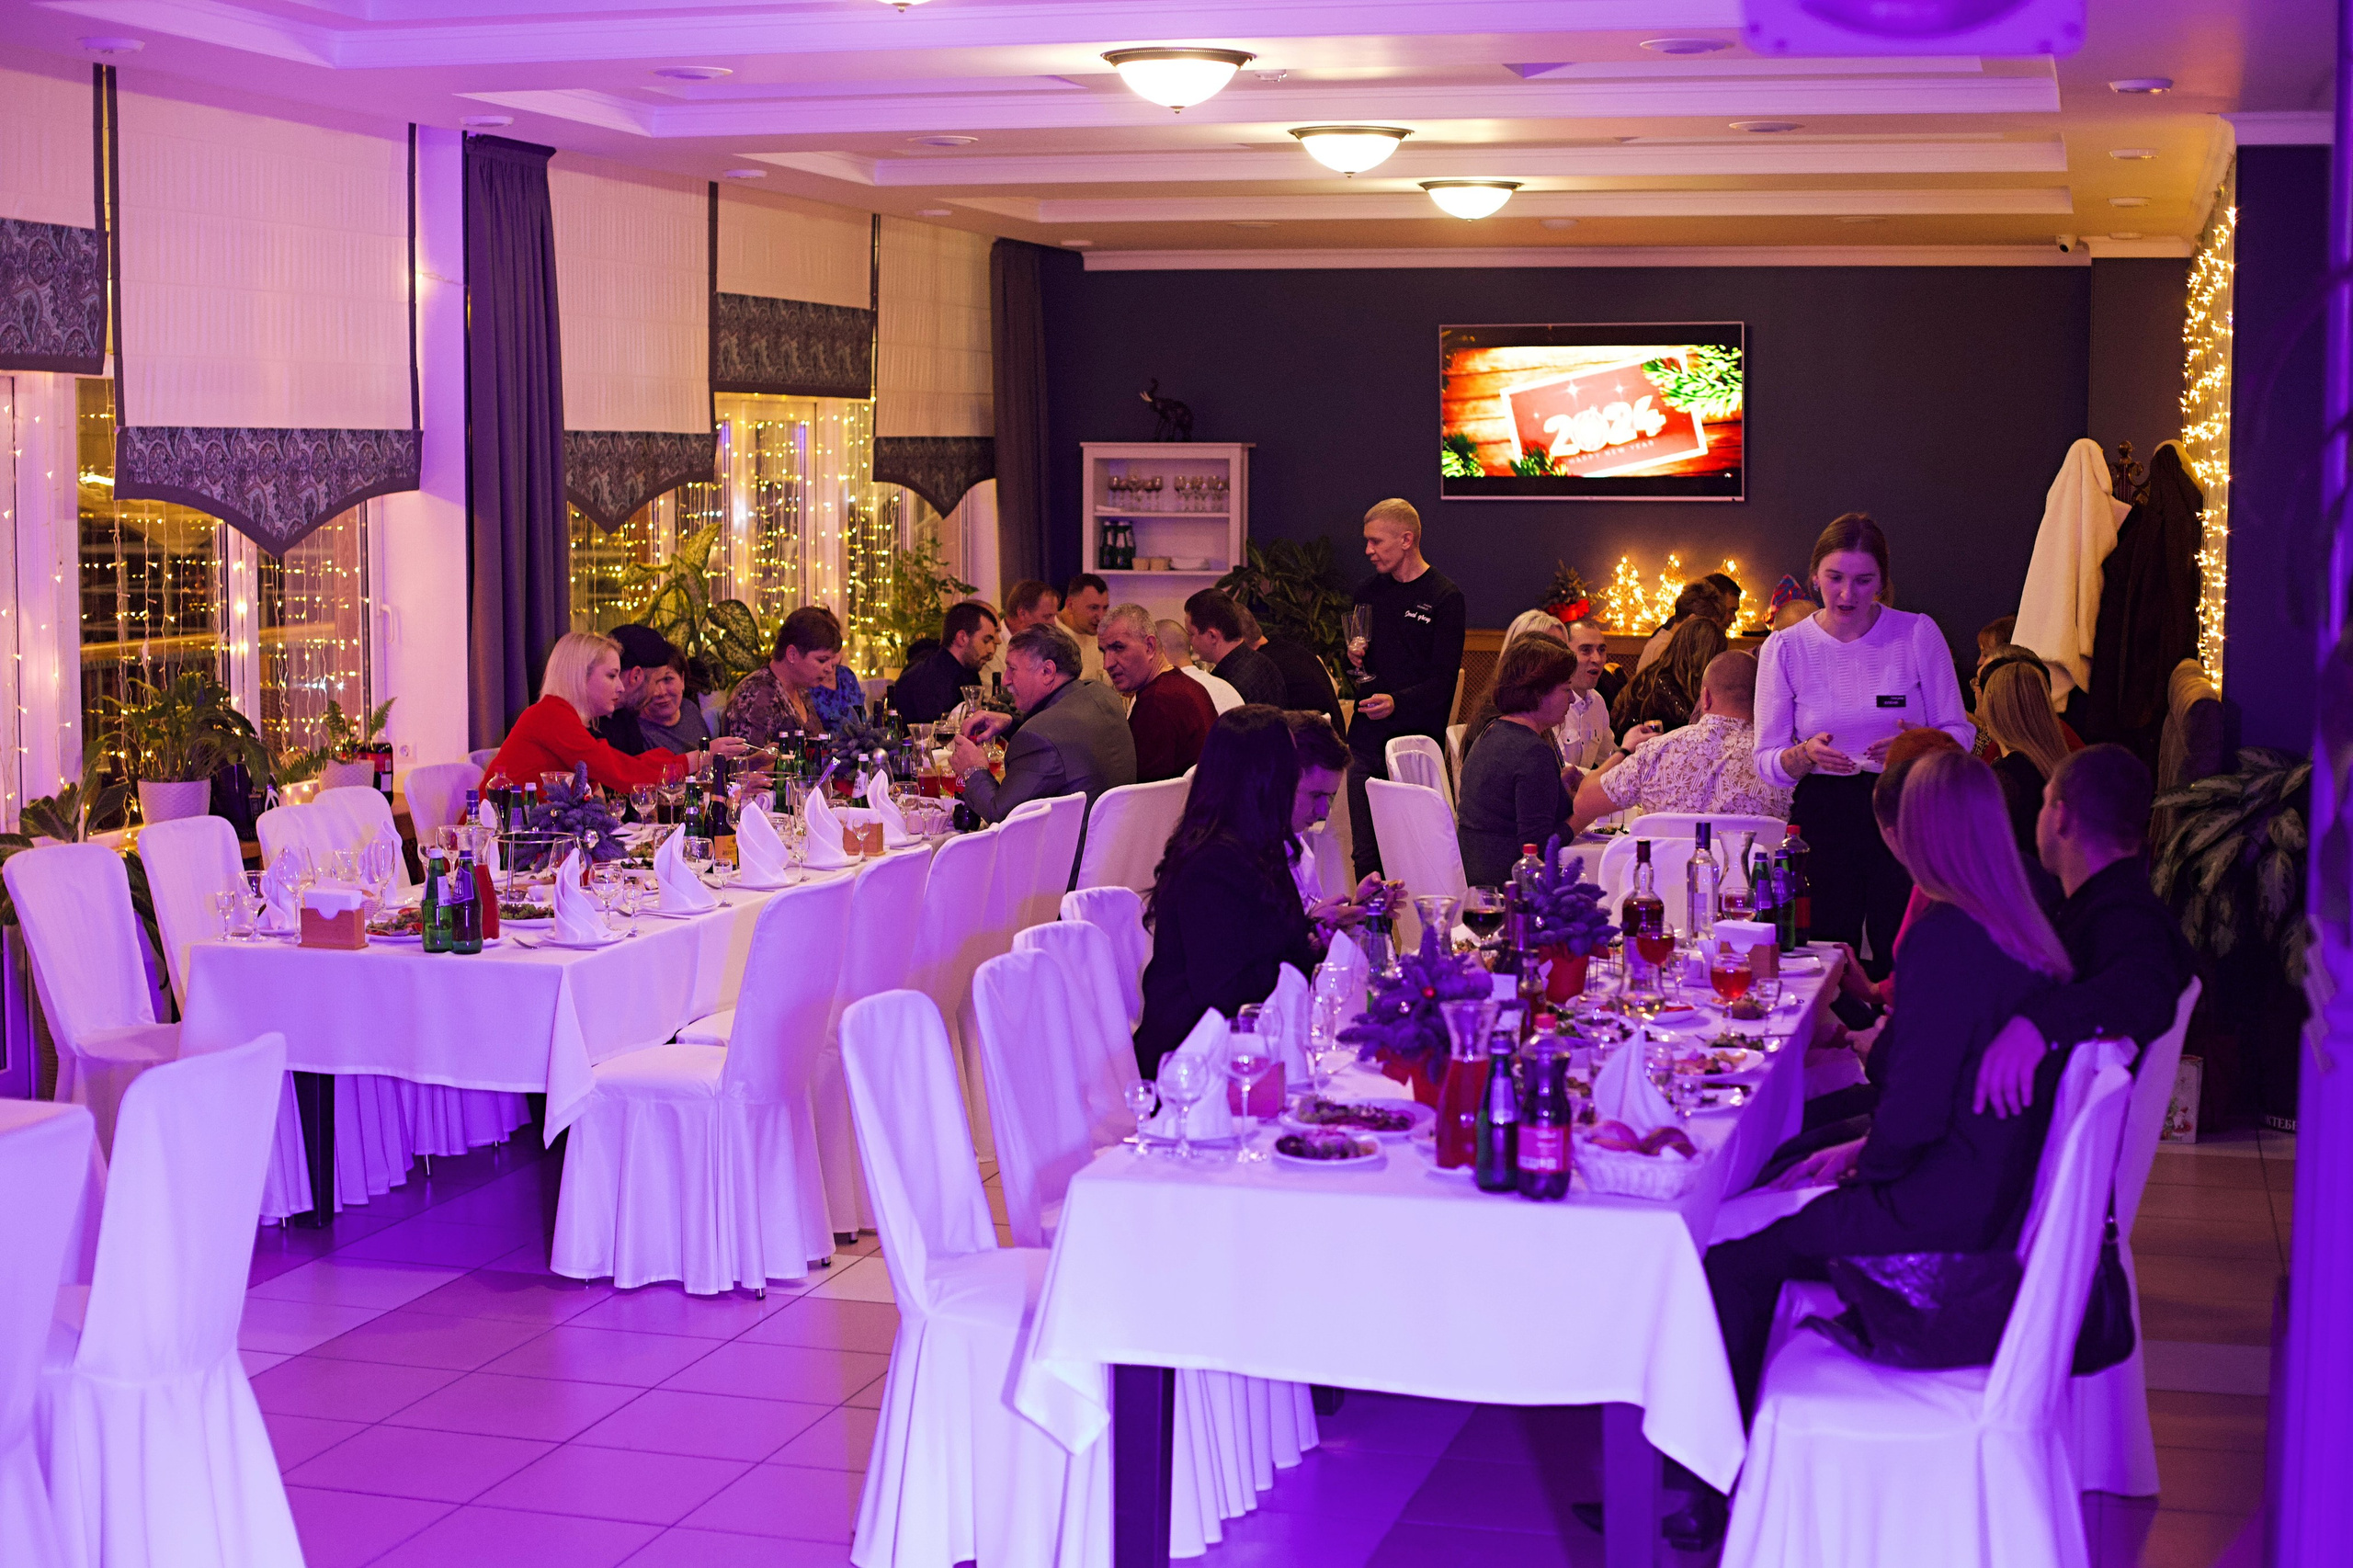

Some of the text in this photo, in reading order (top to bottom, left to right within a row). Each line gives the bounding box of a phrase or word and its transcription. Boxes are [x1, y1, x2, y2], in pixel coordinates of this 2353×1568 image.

[1543, 394, 1666, 457] 2024
[1568, 439, 1654, 465] HAPPY NEW YEAR
